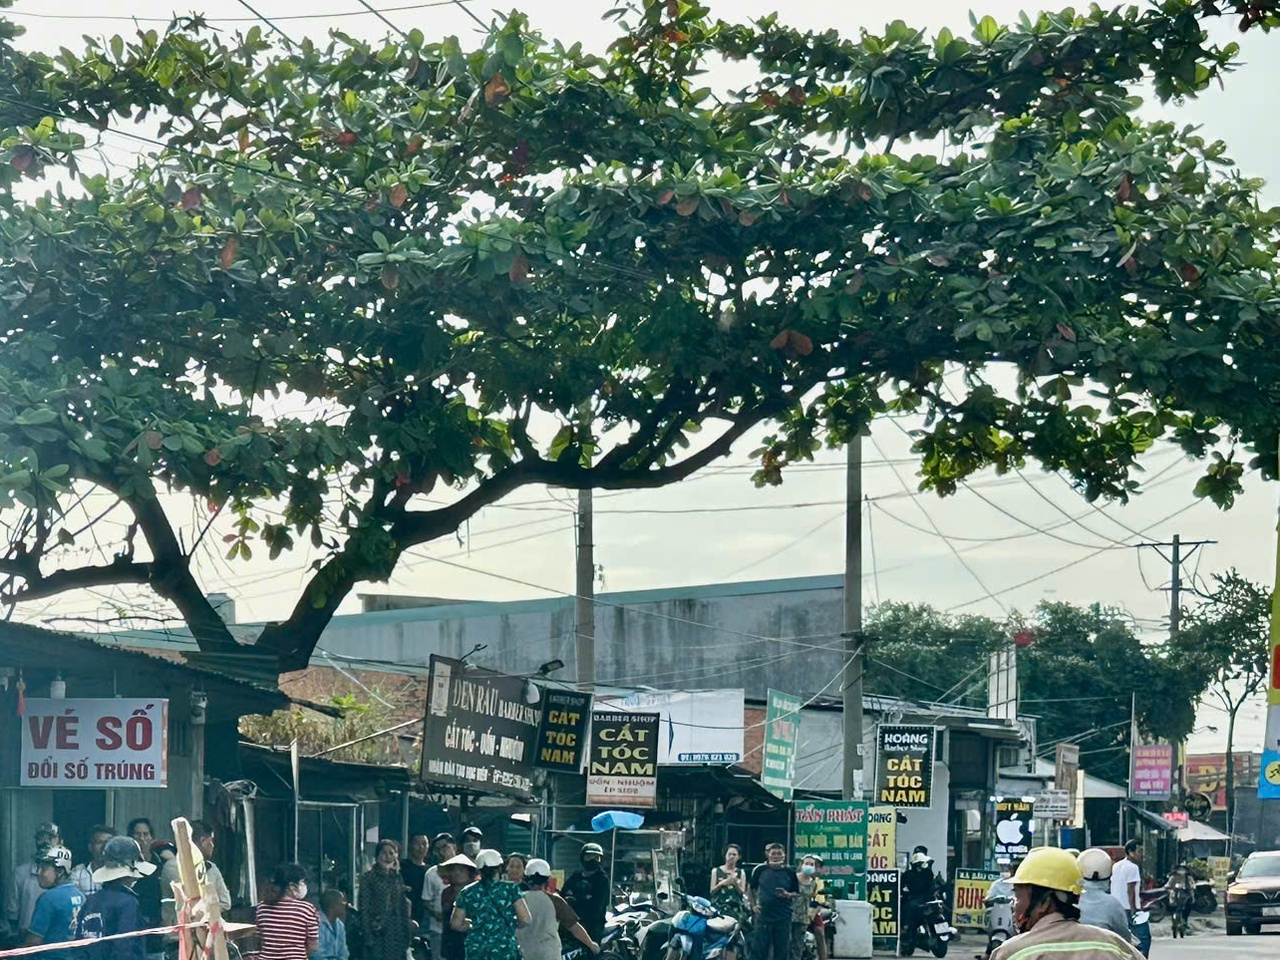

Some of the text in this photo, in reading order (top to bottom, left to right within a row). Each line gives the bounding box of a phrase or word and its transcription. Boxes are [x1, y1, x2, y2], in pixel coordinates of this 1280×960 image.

[28, 704, 155, 751] VÉ SỐ
[598, 723, 649, 742] CẮT
[540, 748, 575, 765] NAM
[597, 743, 649, 760] TÓC
[28, 756, 155, 780] ĐỔI SỐ TRÚNG
[591, 761, 654, 775] NAM
[887, 754, 923, 771] CẮT
[886, 772, 923, 788] TÓC
[881, 789, 926, 803] NAM
[826, 805, 864, 823] PHÁT
